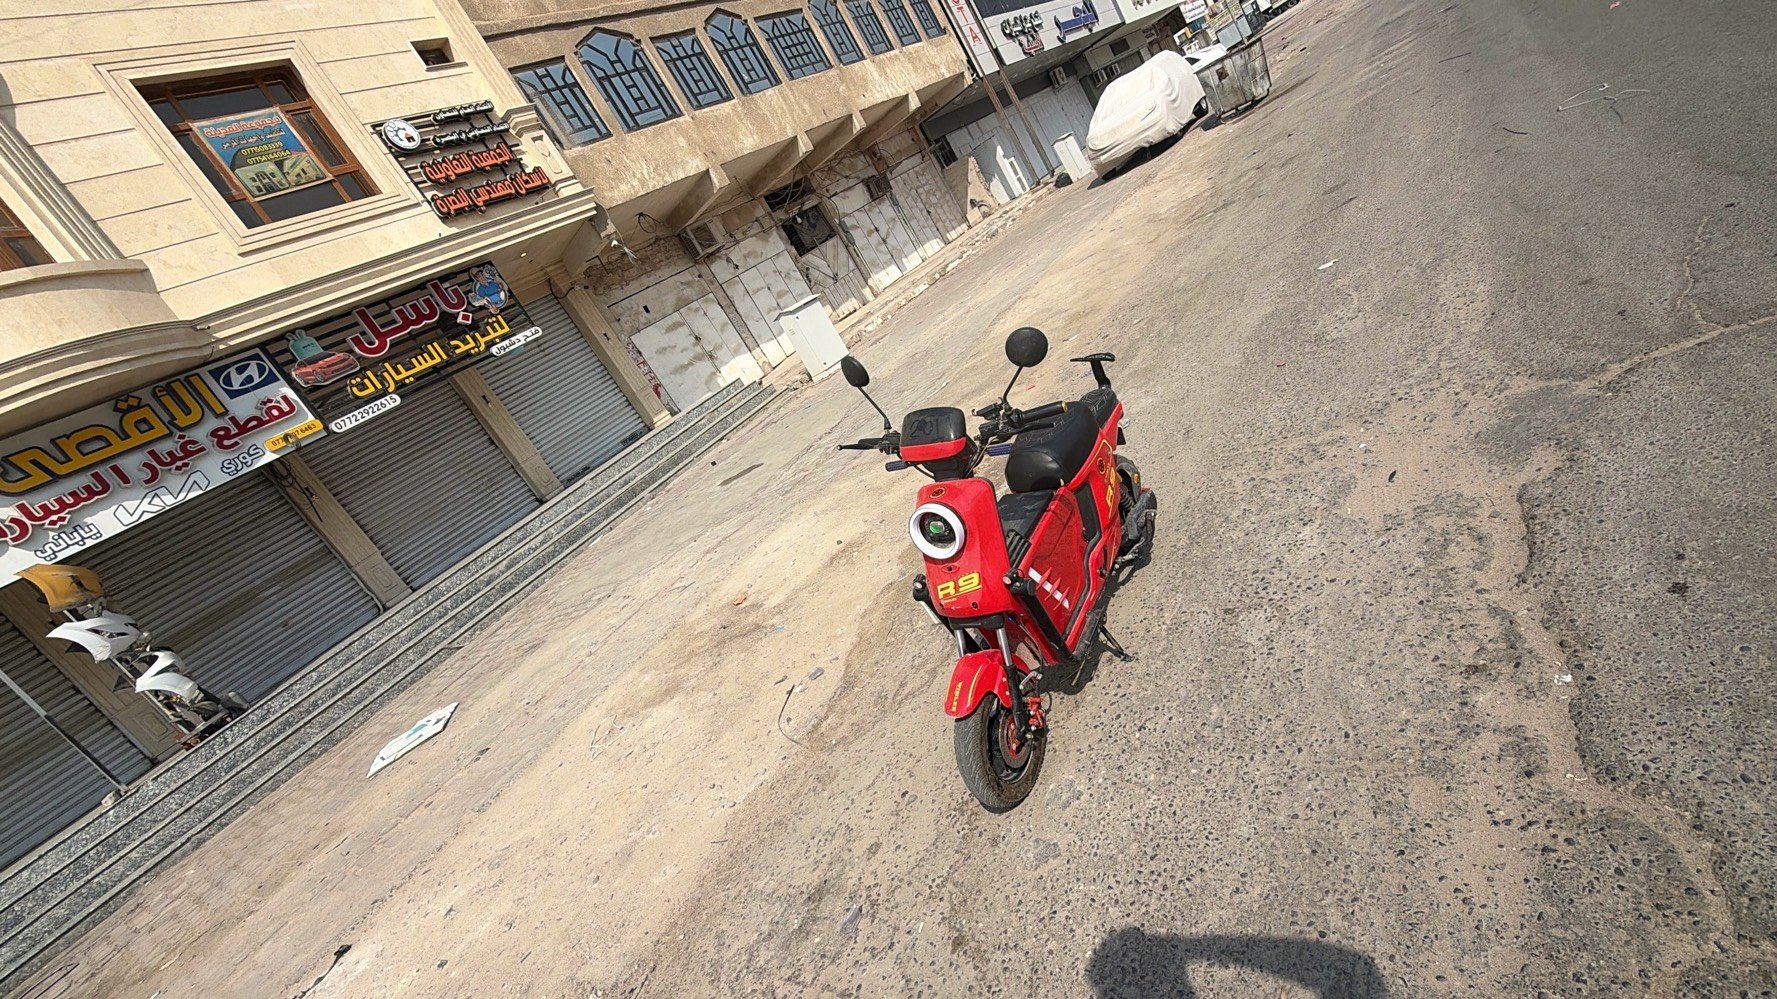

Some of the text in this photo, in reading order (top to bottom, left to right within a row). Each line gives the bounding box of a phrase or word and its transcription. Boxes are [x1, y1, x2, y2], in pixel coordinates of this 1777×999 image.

[422, 143, 512, 183] الجمعية التعاونية
[433, 188, 470, 214] البصرة
[348, 280, 473, 357] باسل
[350, 314, 510, 398] لتبريد السيارات
[209, 392, 298, 452] لقطع
[334, 396, 397, 430] 07722922615
[138, 431, 207, 487] غيار
[220, 444, 266, 476] كوري
[34, 520, 103, 561] ياباني
[937, 571, 981, 600] R9
